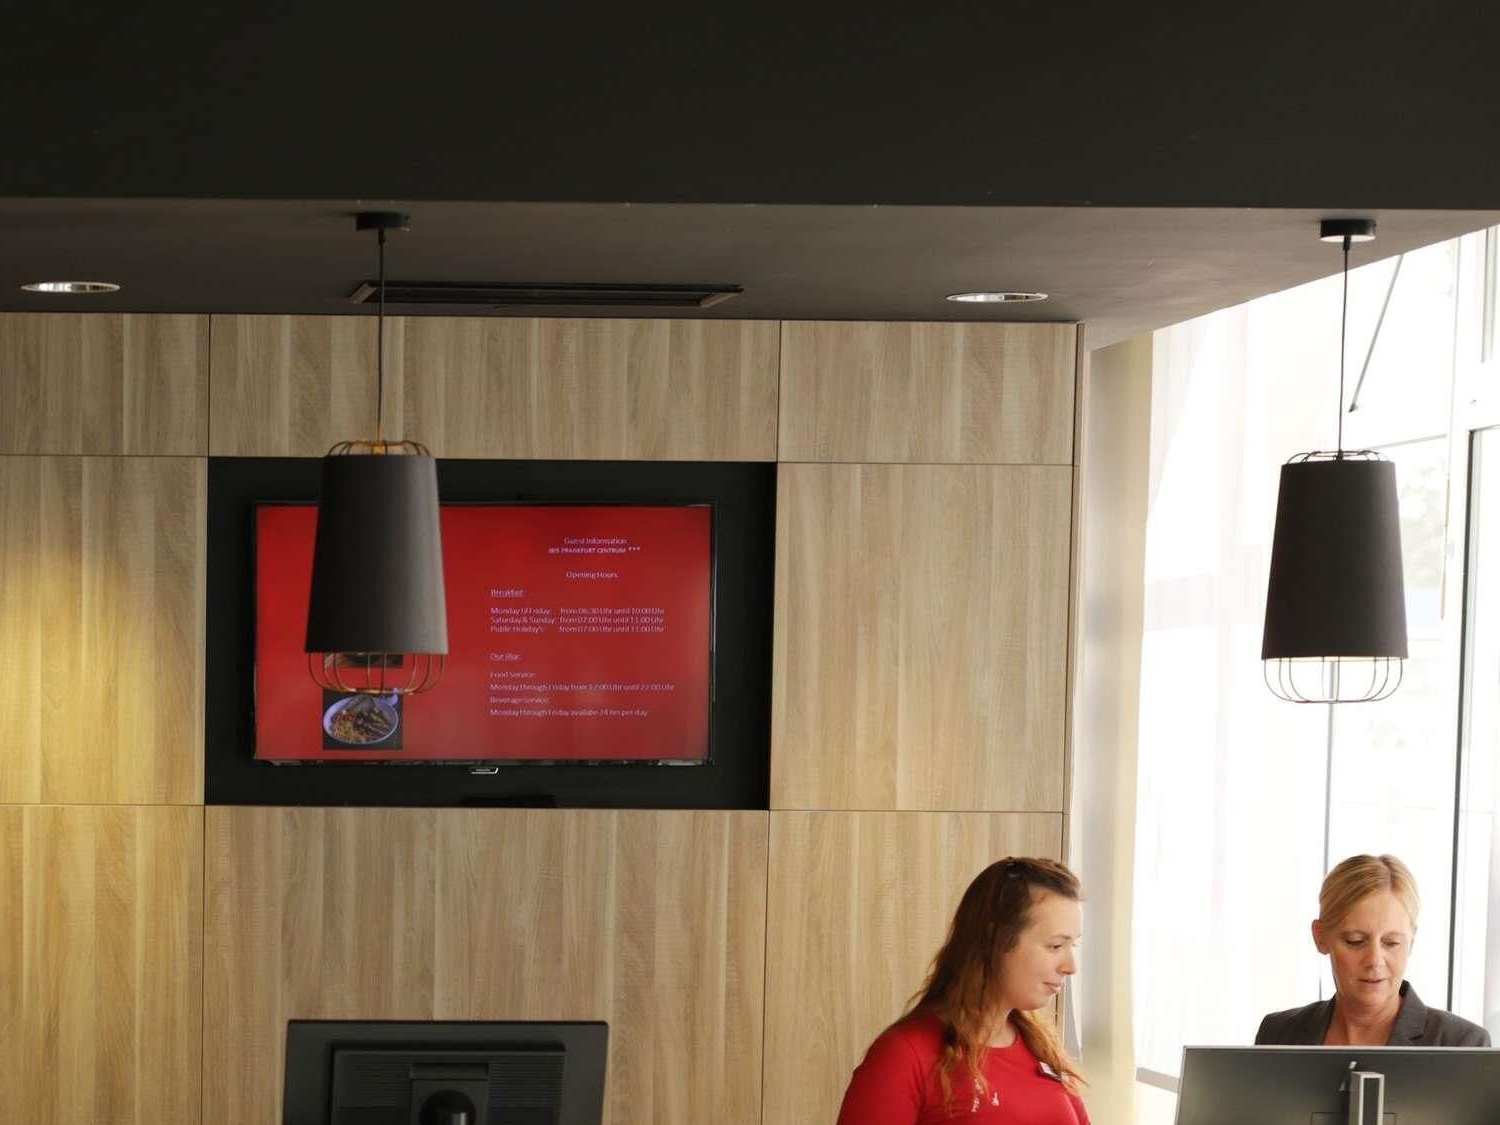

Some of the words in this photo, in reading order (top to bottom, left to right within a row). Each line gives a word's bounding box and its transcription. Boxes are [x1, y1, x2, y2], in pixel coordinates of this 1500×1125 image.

[586, 537, 628, 545] Information
[565, 570, 597, 580] Opening
[490, 607, 520, 617] Monday
